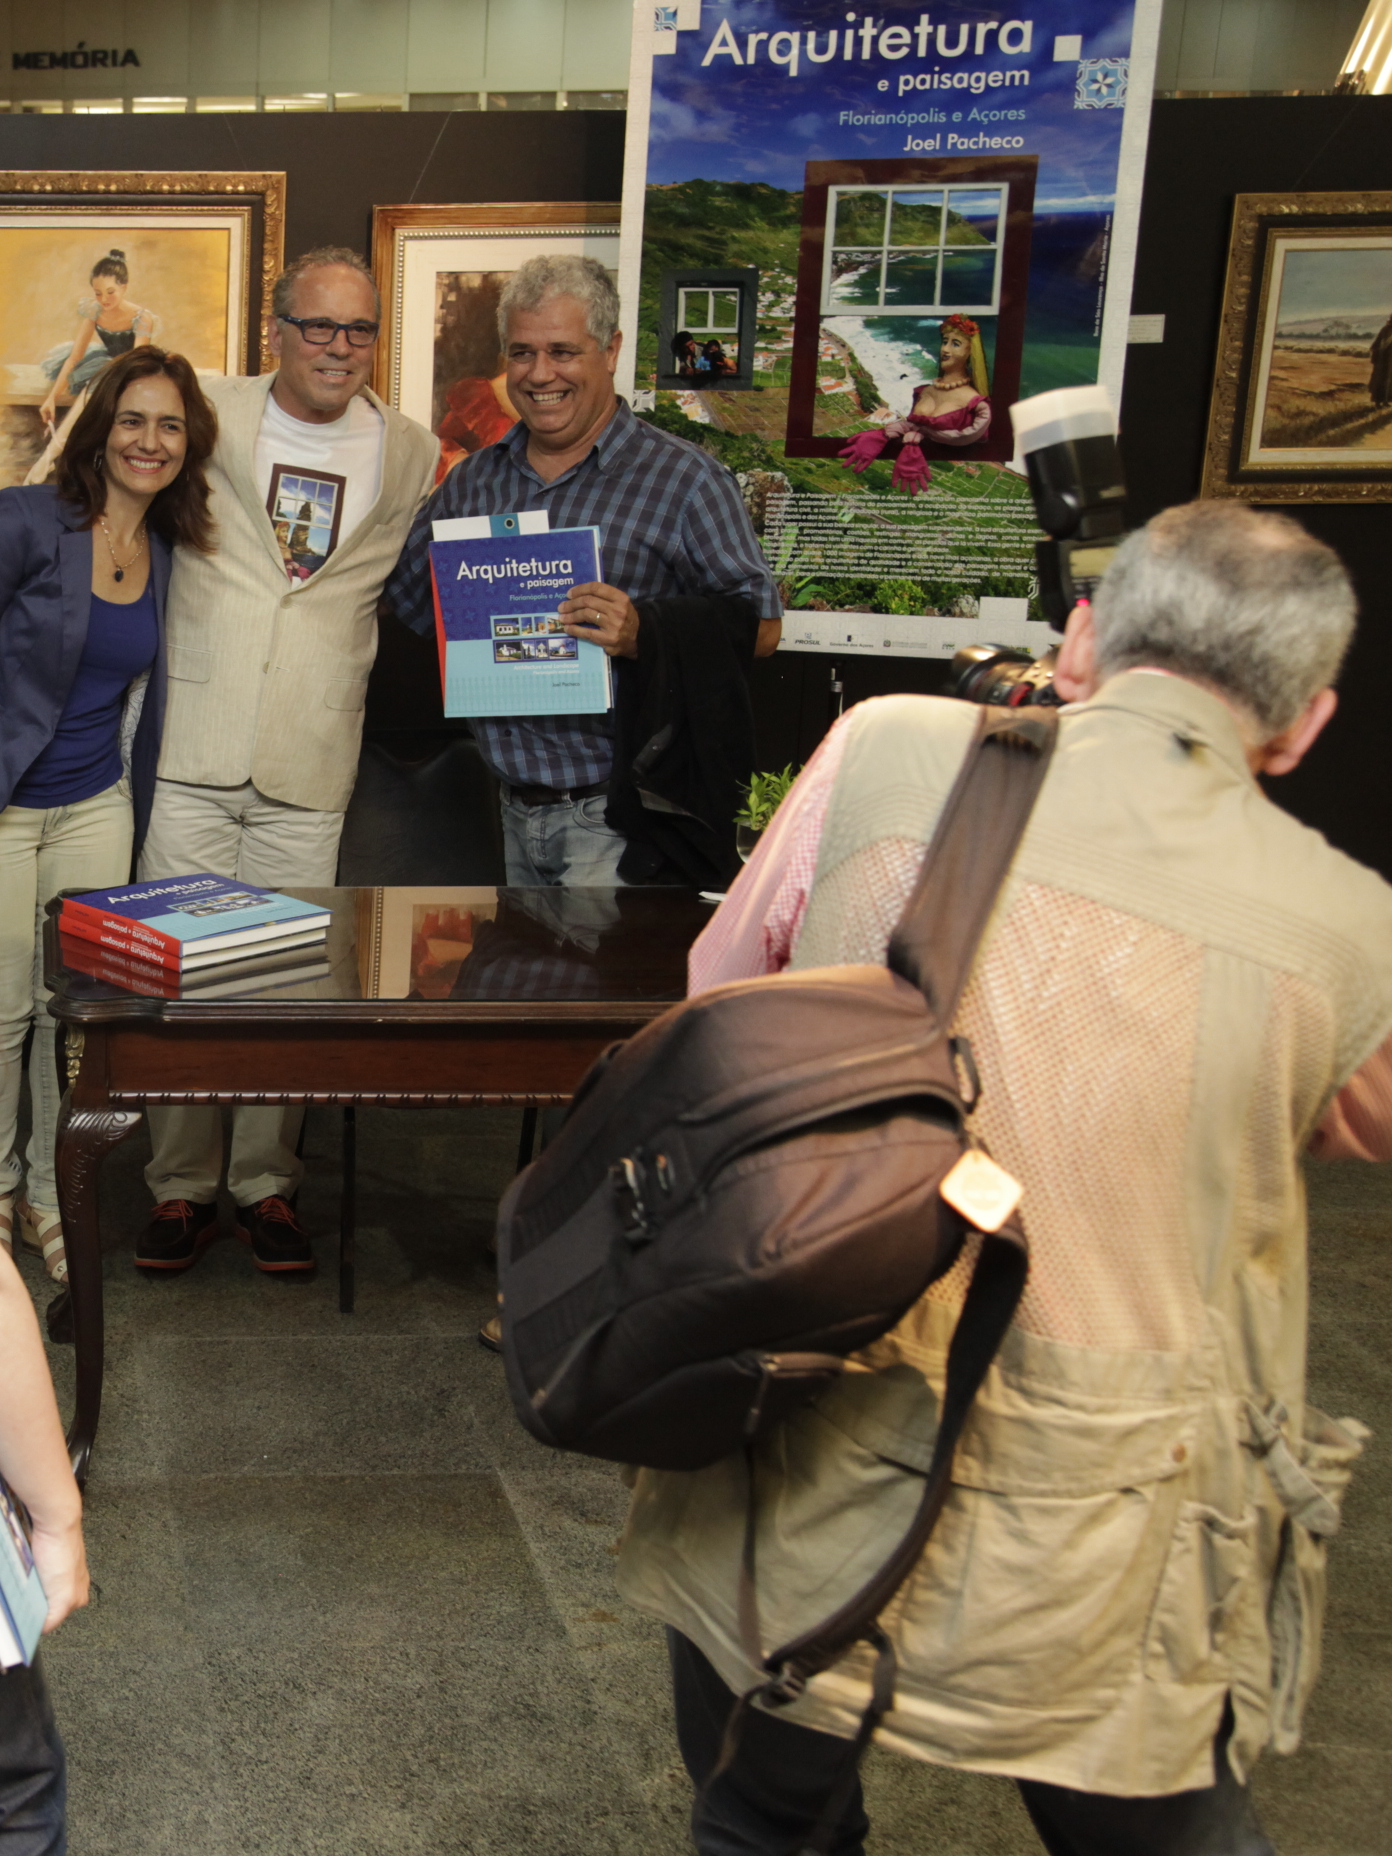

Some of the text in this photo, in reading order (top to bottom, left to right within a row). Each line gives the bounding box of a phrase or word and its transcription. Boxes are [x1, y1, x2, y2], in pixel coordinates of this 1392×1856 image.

[701, 11, 1033, 77] Arquitetura
[12, 42, 141, 70] MEMÓRIA
[877, 66, 1030, 97] e paisagem
[839, 107, 1026, 127] Florianópolis e Açores
[903, 131, 1025, 152] Joel Pacheco
[457, 557, 572, 583] Arquitetura
[527, 577, 574, 590] paisagem
[509, 593, 548, 601] Florianópolis
[107, 879, 217, 904] Arquitetura
[182, 883, 225, 895] paisagem
[102, 919, 128, 934] paisagem
[100, 935, 126, 949] paisagem
[132, 931, 166, 950] Arquitetura
[130, 946, 165, 965] Arquitetura
